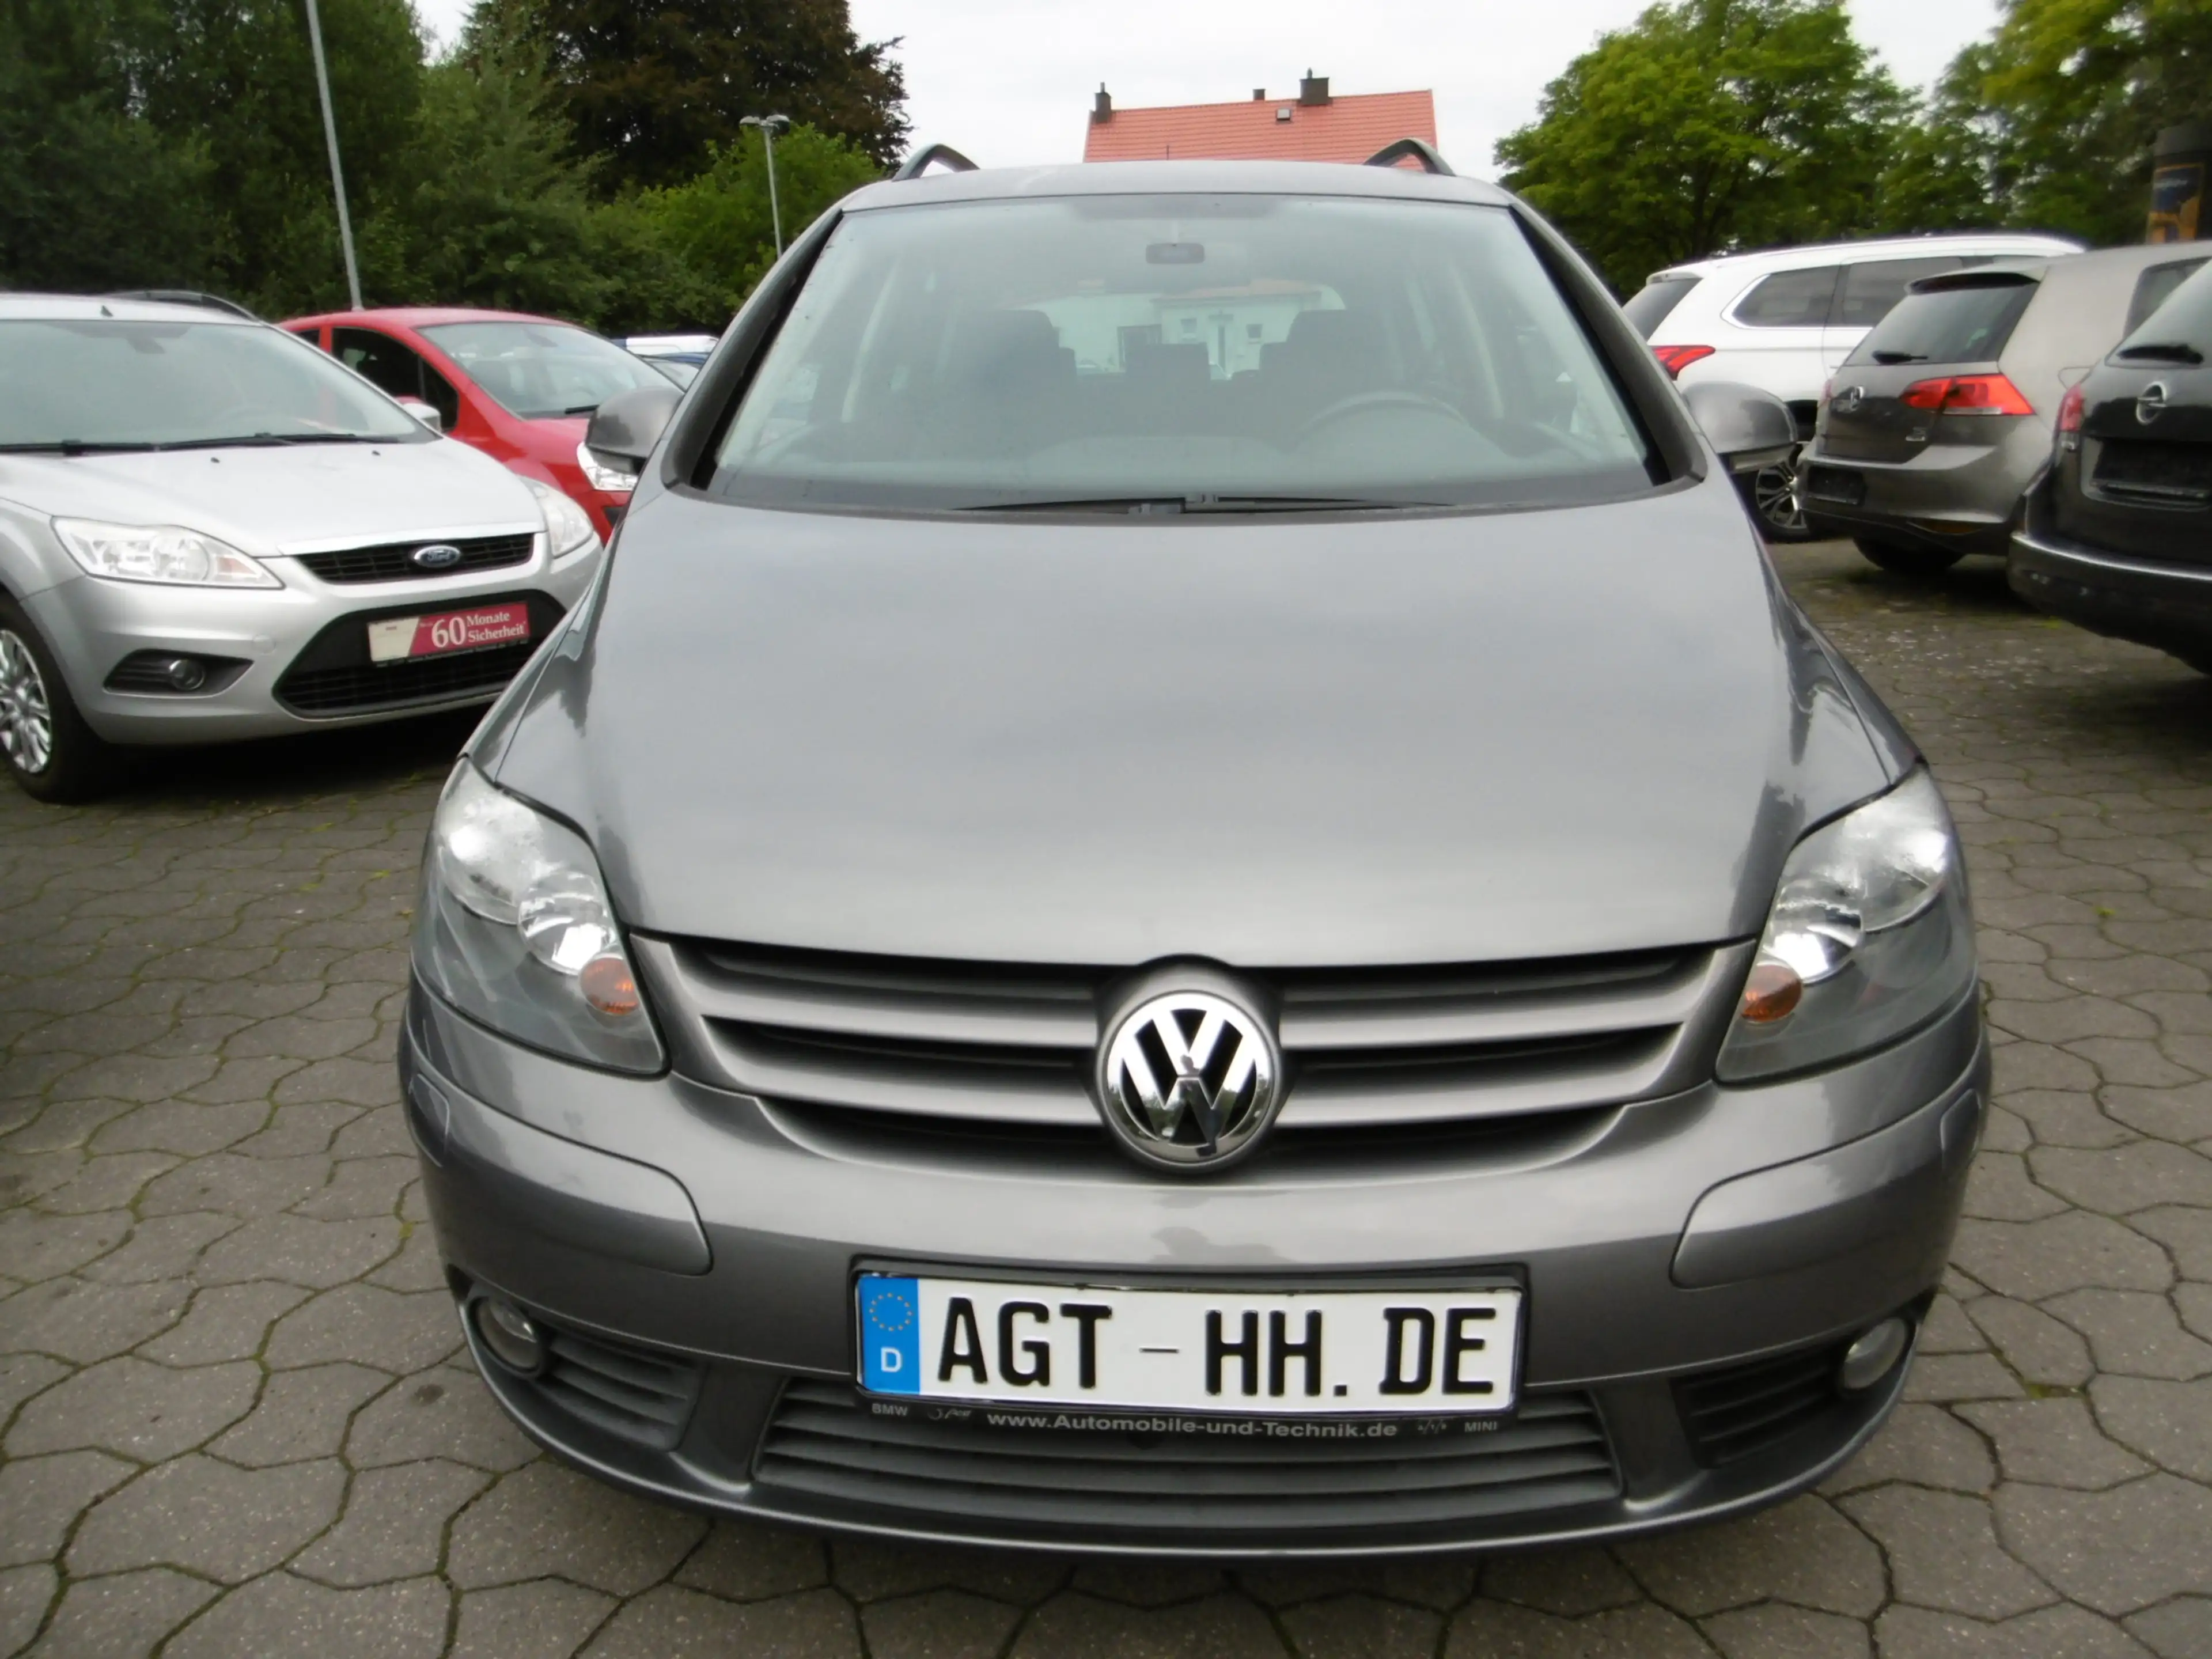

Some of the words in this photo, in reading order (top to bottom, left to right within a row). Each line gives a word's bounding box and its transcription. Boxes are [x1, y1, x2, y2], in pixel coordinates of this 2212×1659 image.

[431, 617, 465, 647] 60
[467, 612, 510, 627] Monate
[468, 624, 524, 643] Sicherheit
[881, 1346, 903, 1373] D
[937, 1296, 1112, 1389] AGT
[1377, 1306, 1497, 1395] DE
[872, 1403, 908, 1416] BMW
[987, 1412, 1398, 1438] www.Automobile-und-Technik.de
[1464, 1421, 1498, 1433] MINI
